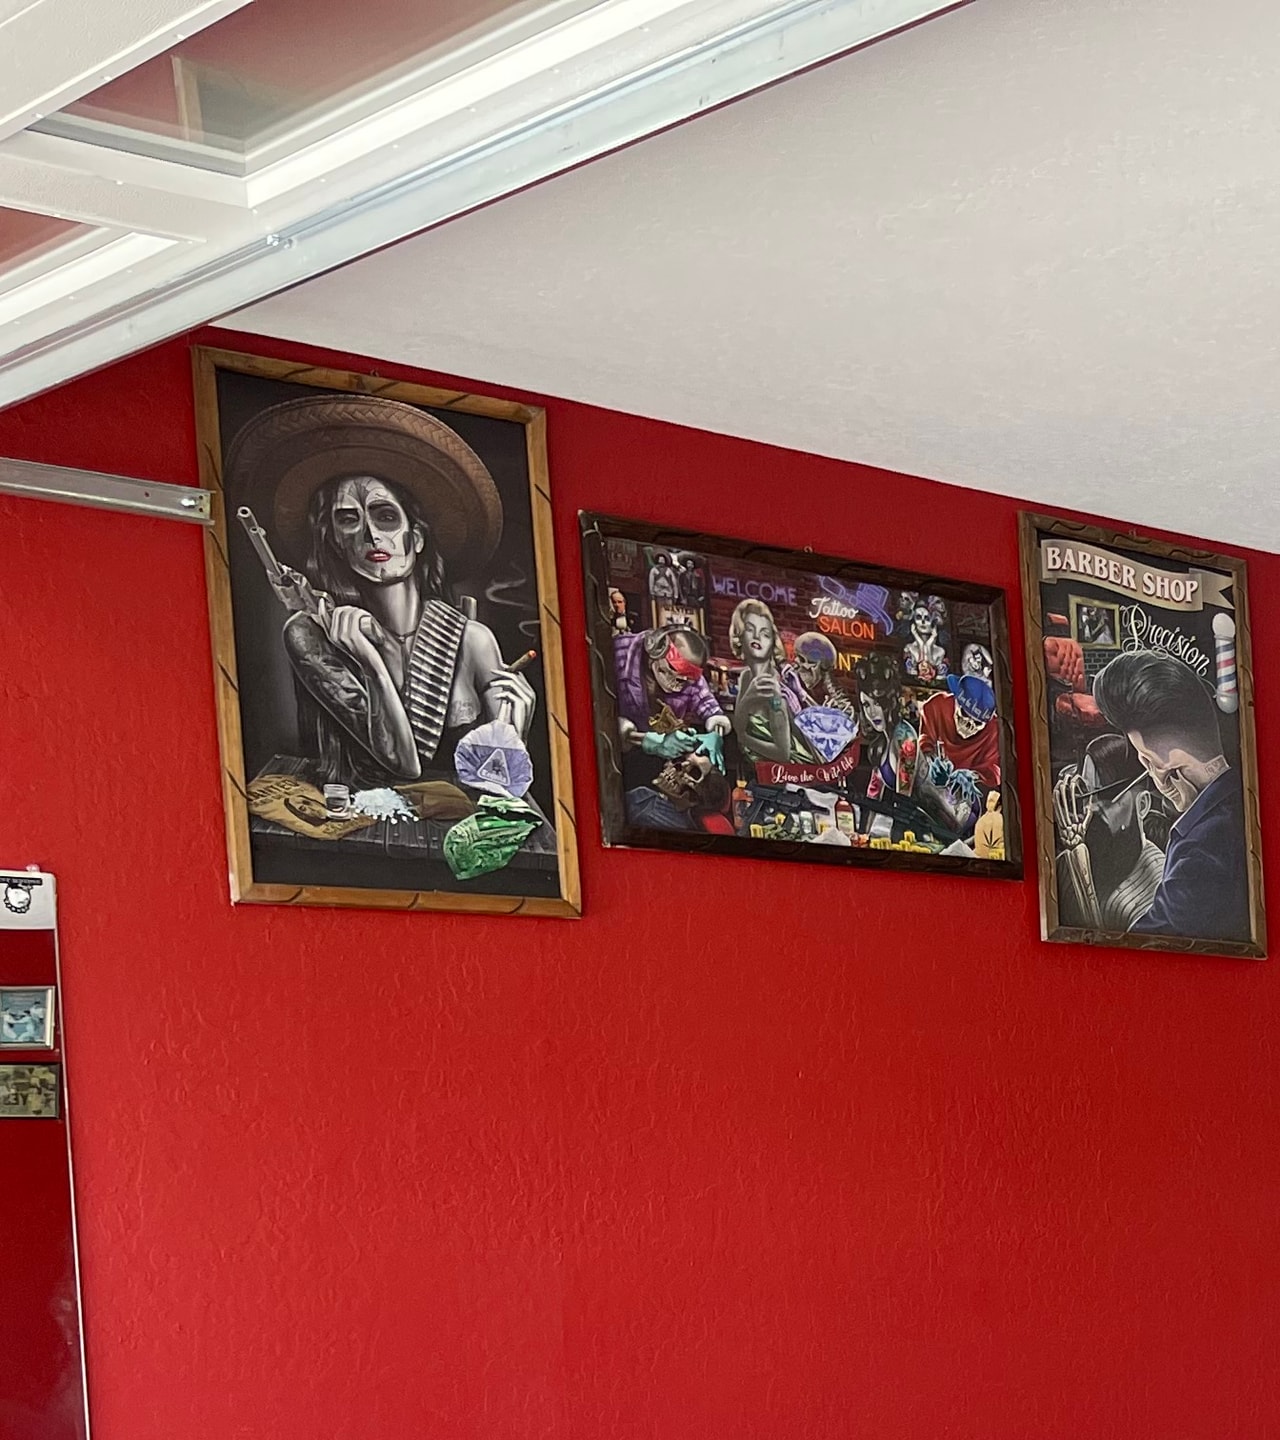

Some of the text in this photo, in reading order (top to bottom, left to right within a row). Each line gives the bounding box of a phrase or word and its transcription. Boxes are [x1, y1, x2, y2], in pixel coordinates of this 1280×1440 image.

[1047, 547, 1198, 603] BARBER SHOP
[712, 575, 798, 606] WELCOME
[809, 597, 859, 619] Tattoo
[819, 616, 874, 640] SALON
[1120, 603, 1210, 676] Precision
[771, 763, 798, 784] Live
[800, 770, 814, 782] the
